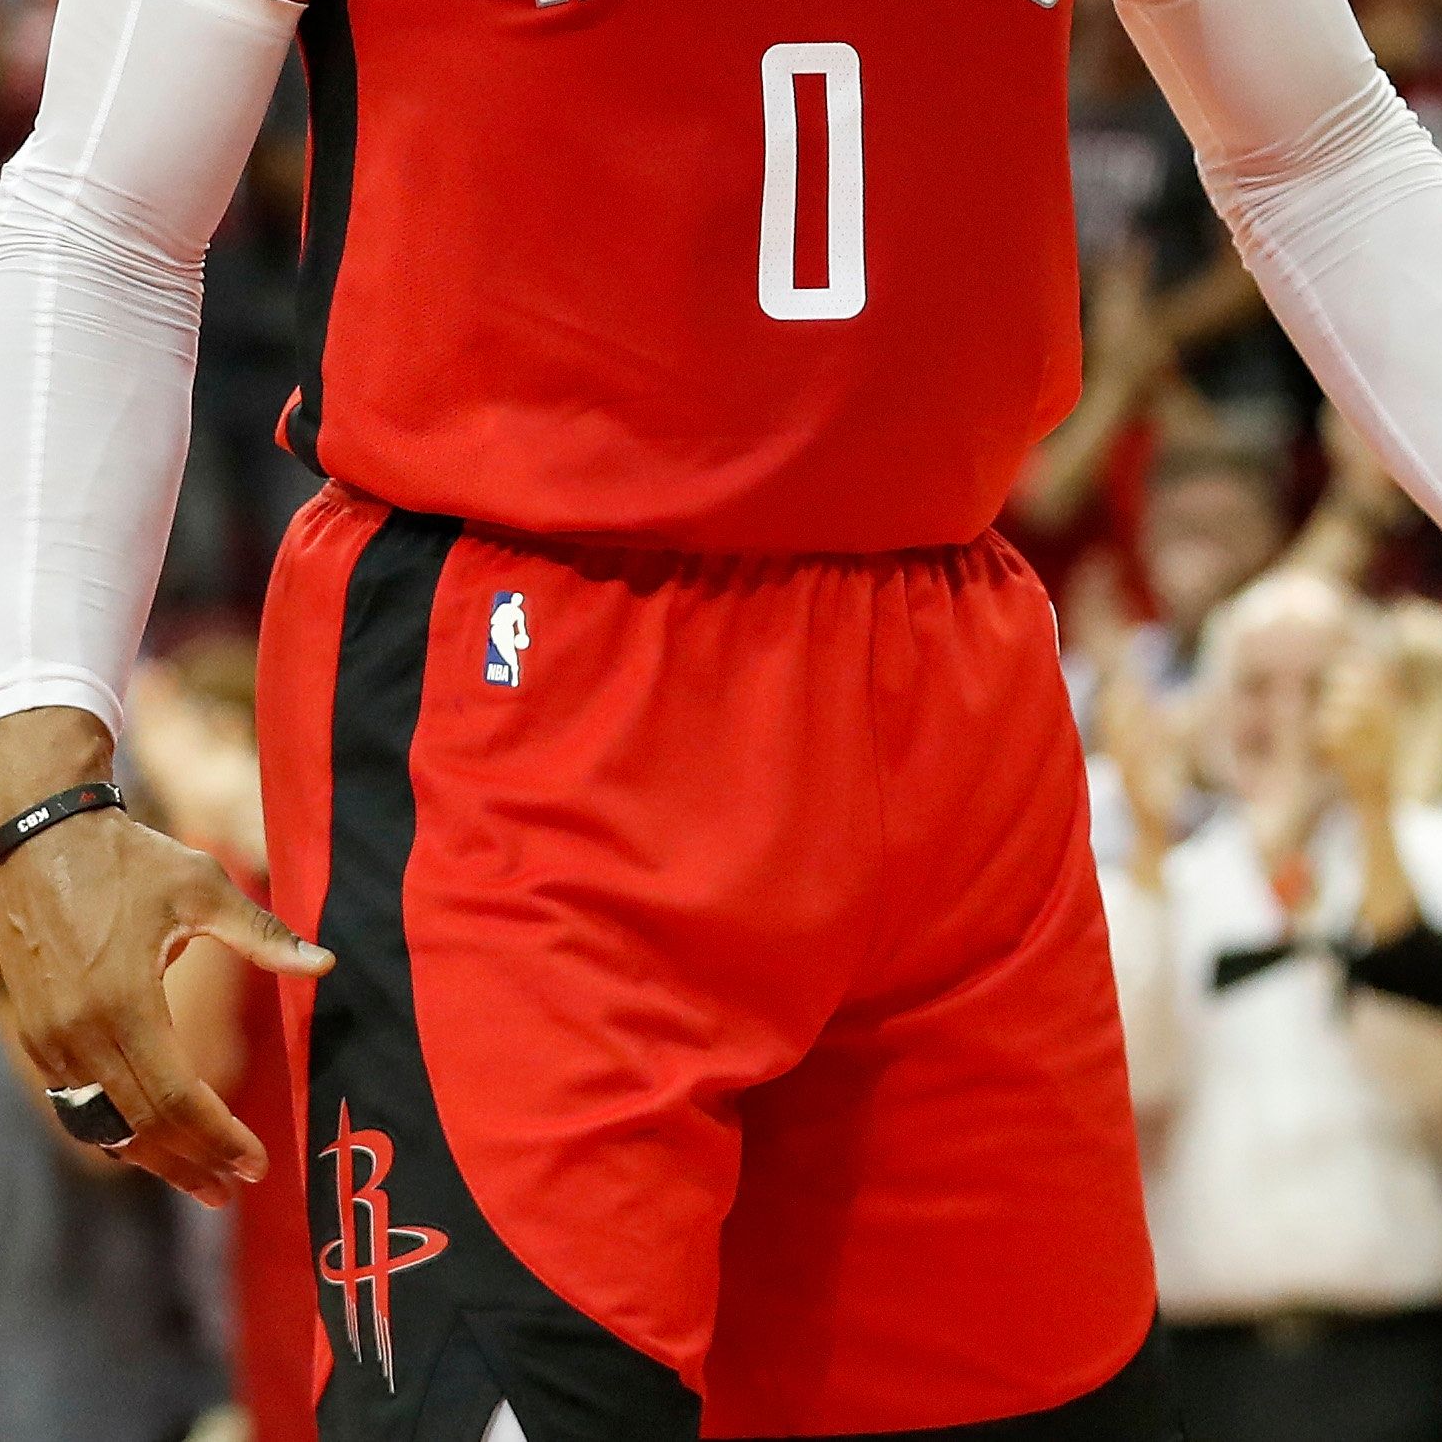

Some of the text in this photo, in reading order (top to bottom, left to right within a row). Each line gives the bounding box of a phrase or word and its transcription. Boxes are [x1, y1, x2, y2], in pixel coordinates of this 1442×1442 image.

[758, 42, 867, 321] 0
[486, 663, 510, 682] NBA
[17, 807, 50, 833] KB3
